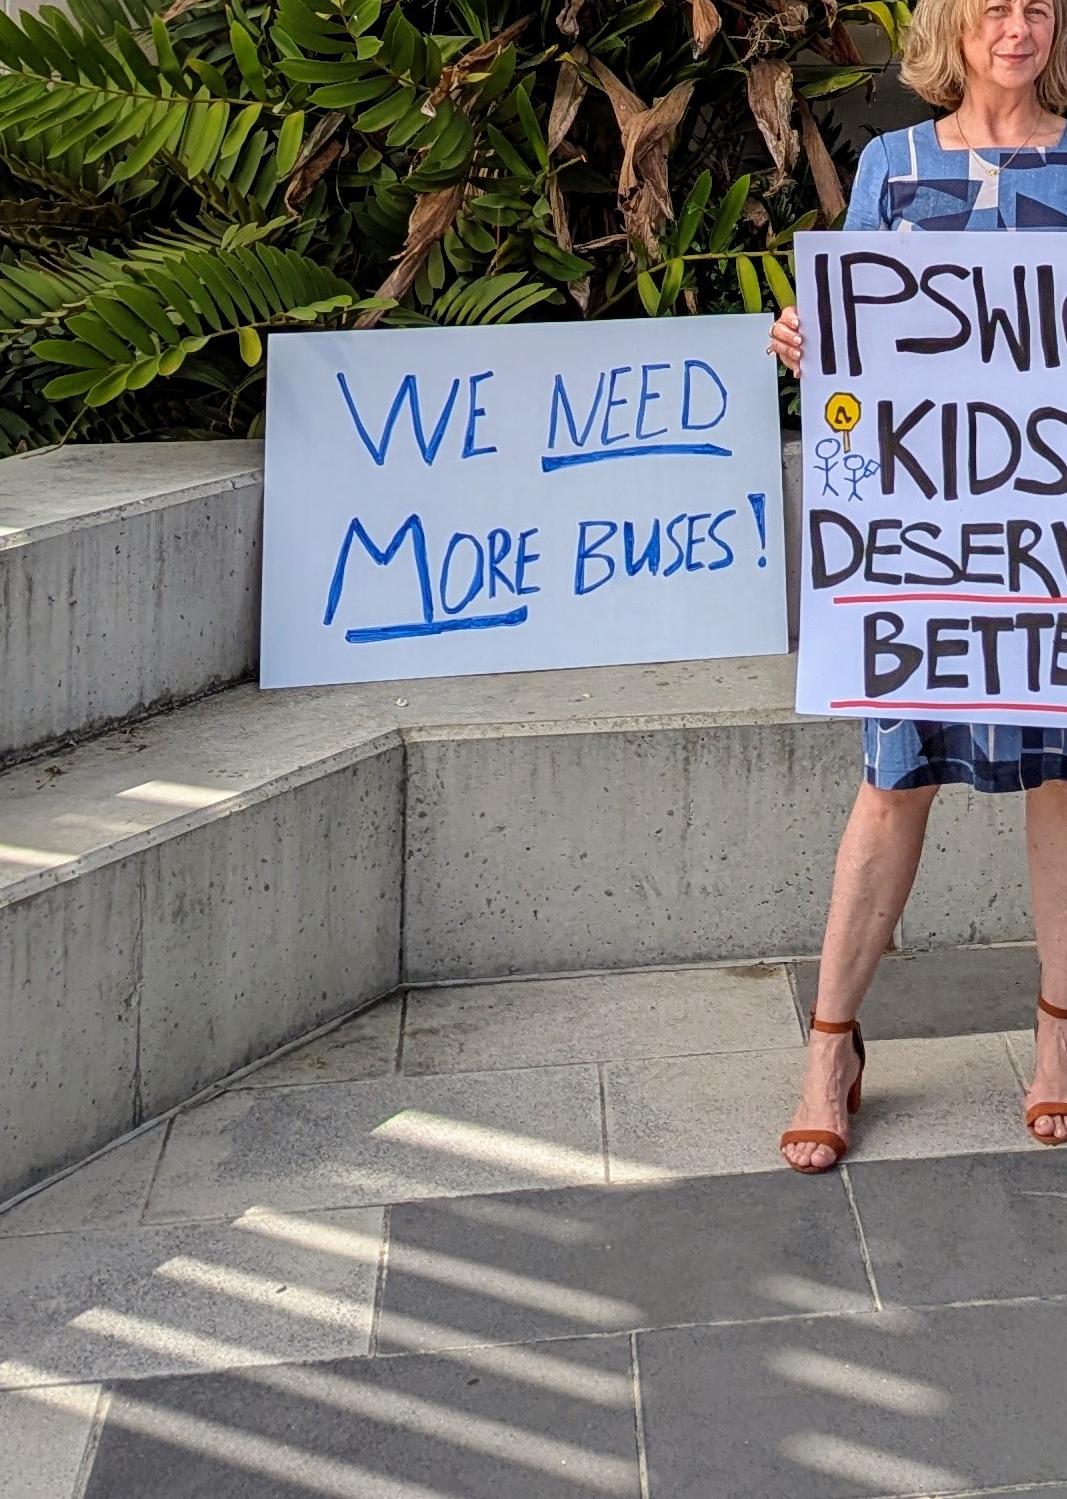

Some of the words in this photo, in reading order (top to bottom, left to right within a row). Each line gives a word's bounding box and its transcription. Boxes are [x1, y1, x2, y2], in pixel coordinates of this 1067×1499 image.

[336, 370, 498, 466] WE
[547, 359, 728, 450] NEED
[323, 513, 541, 625] MORE
[574, 493, 767, 595] BUSES!
